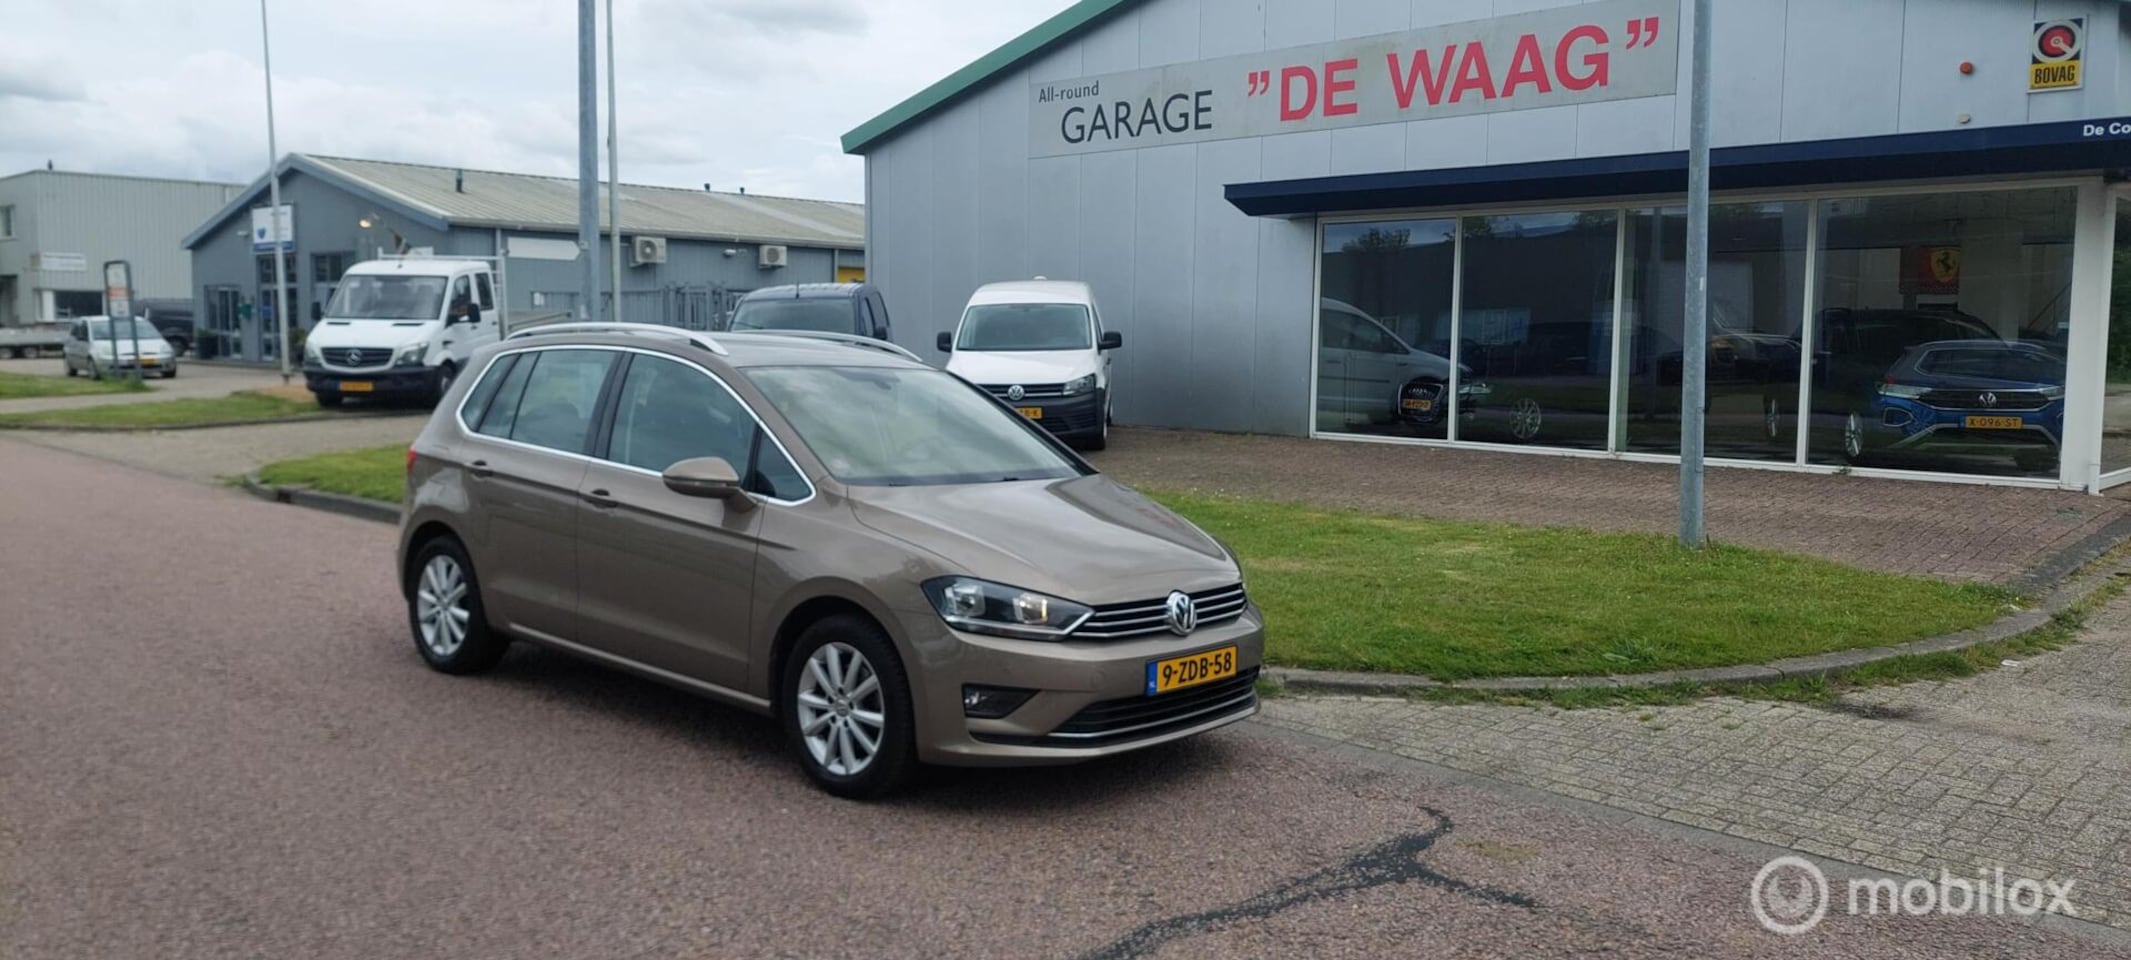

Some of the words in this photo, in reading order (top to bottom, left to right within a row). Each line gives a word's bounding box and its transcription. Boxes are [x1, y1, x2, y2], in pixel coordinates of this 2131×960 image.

[2034, 64, 2075, 84] BOVAG
[1039, 80, 1100, 103] All-round
[1061, 90, 1213, 144] GARAGE
[2083, 124, 2105, 136] De
[1162, 651, 1232, 687] 9-ZDB-58
